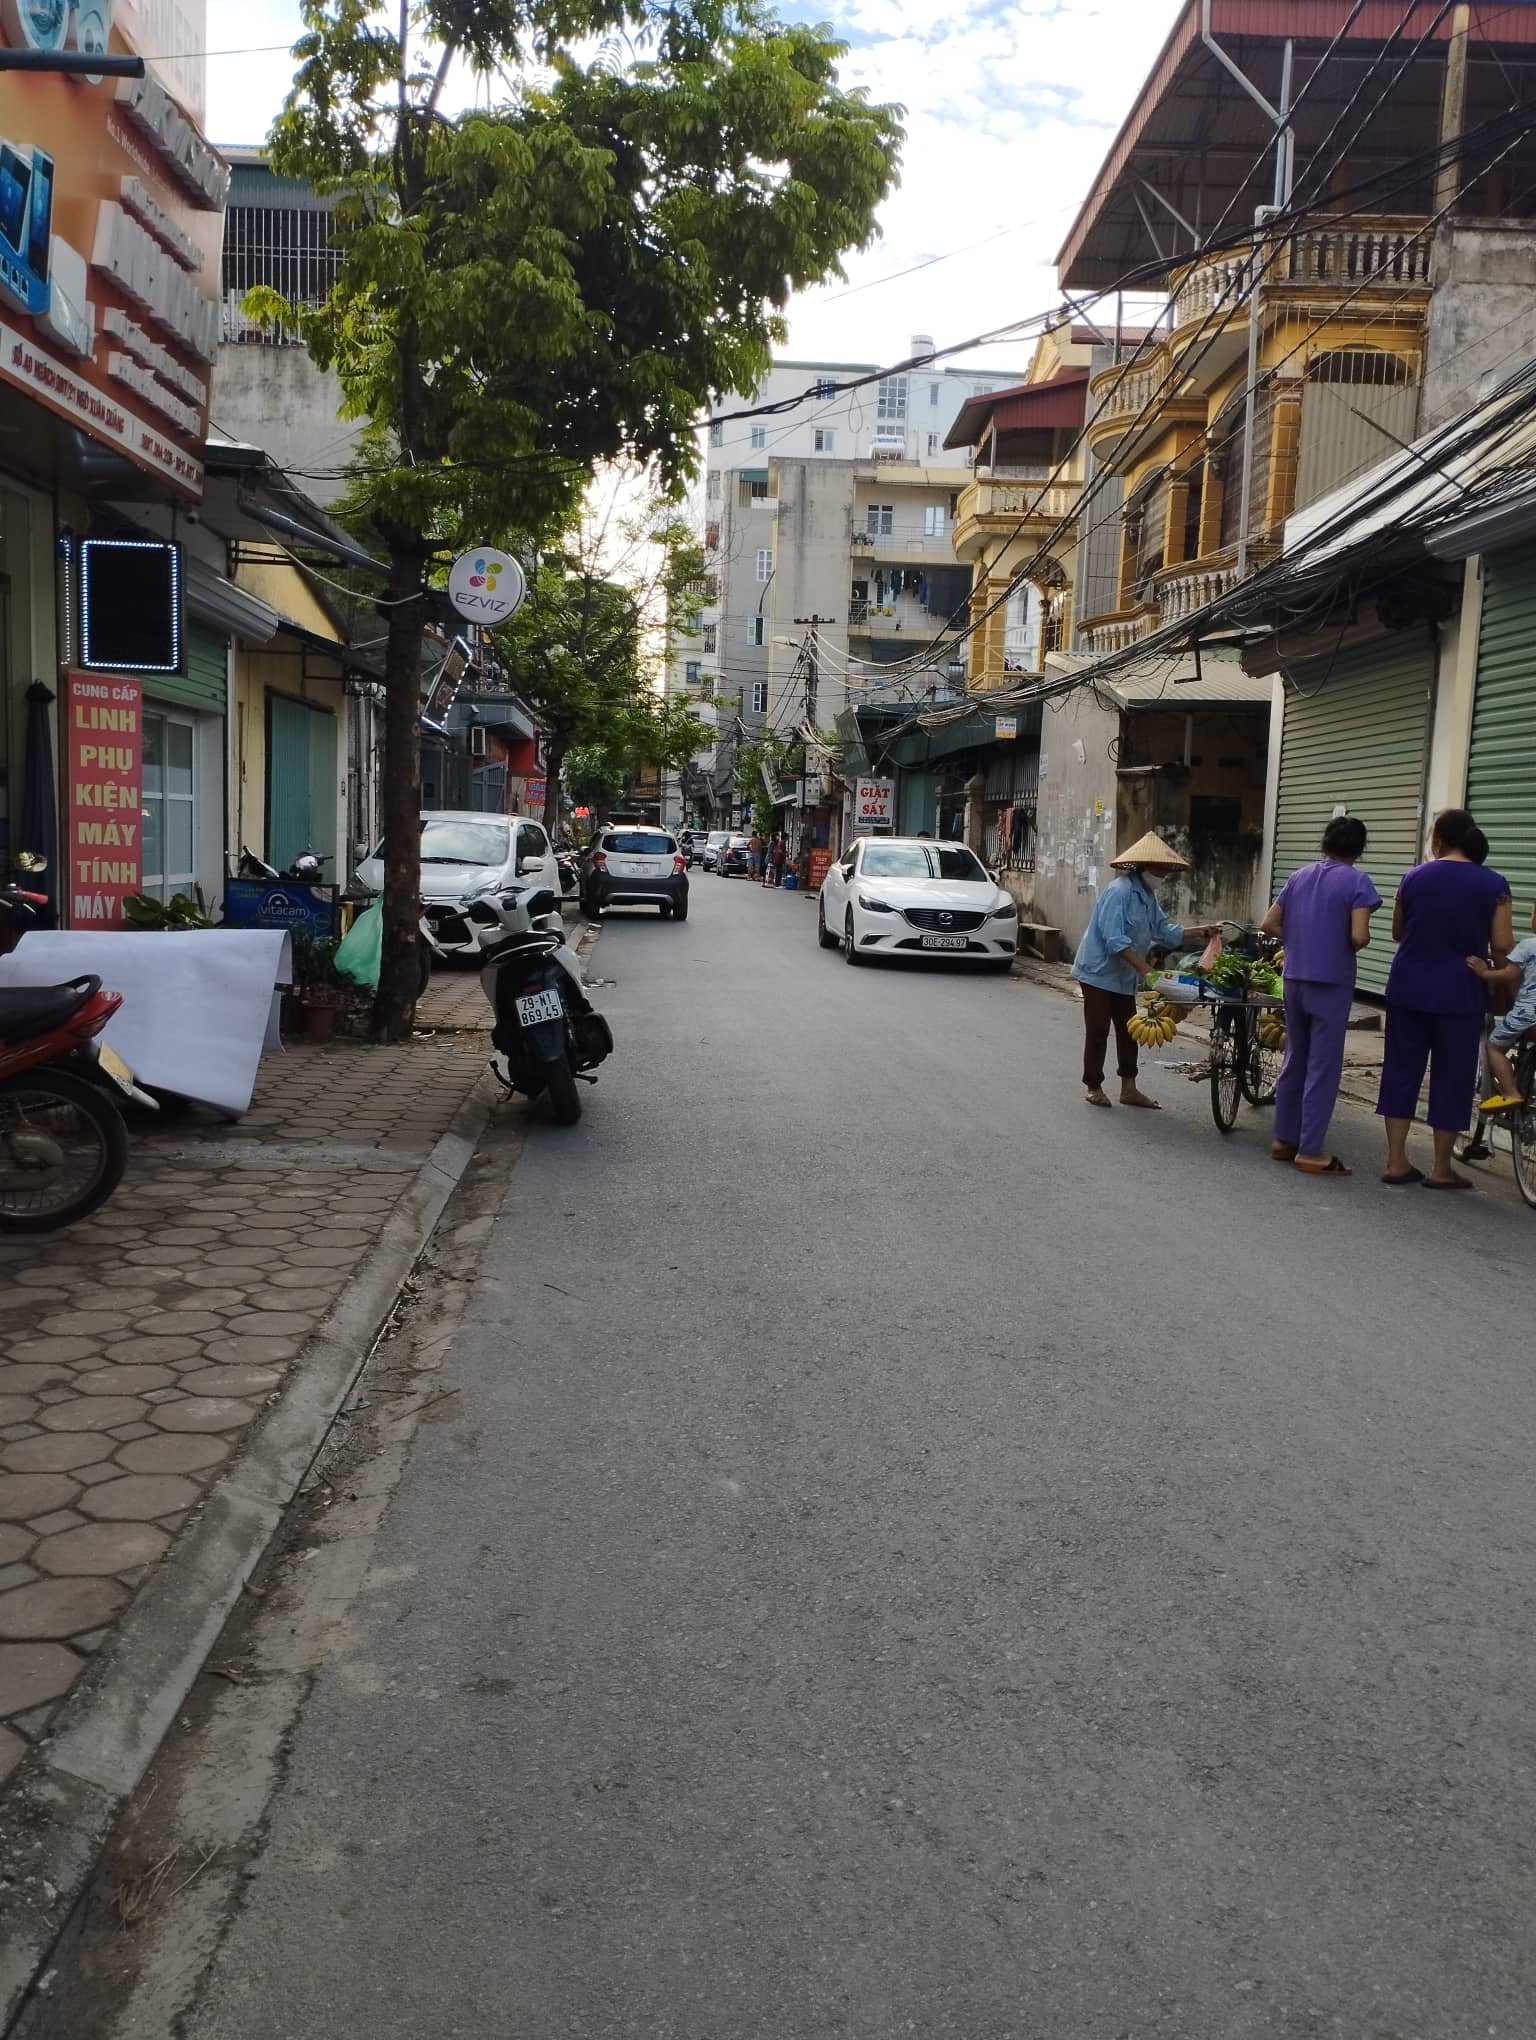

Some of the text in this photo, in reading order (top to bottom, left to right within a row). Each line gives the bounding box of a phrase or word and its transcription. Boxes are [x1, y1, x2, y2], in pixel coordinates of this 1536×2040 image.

[455, 592, 507, 613] EZVIZ
[72, 683, 138, 701] CUNG CẤP
[75, 705, 136, 733] LINH
[80, 744, 133, 776] PHỤ
[75, 780, 138, 812] KIỆN
[78, 819, 137, 847] MÁY
[76, 857, 137, 884] TÍNH
[74, 890, 116, 919] MÁY
[260, 904, 306, 917] vitacam
